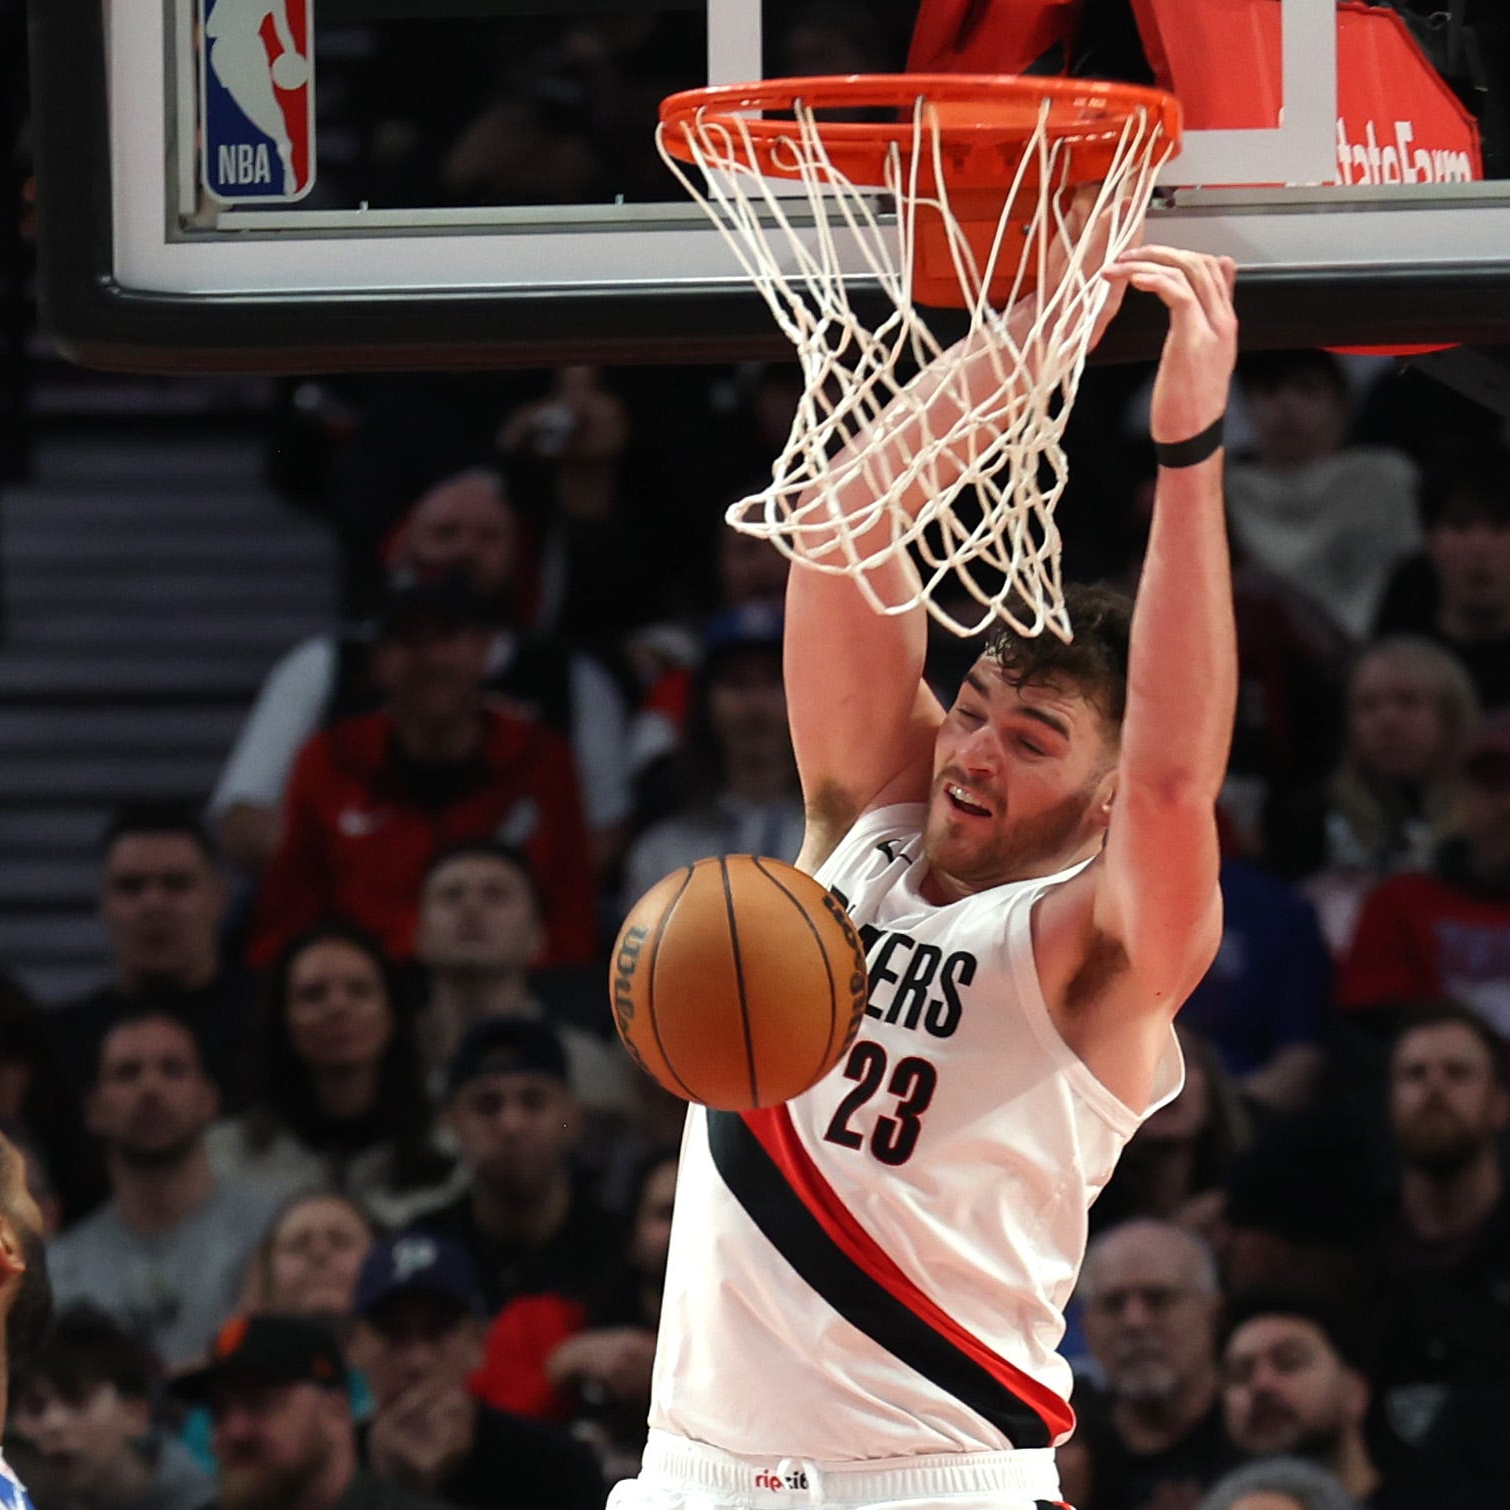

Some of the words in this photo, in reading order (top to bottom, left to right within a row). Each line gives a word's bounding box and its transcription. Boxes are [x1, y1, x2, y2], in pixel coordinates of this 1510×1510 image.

[217, 143, 272, 185] NBA
[1334, 116, 1472, 186] tateFarm
[823, 1040, 938, 1166] 23
